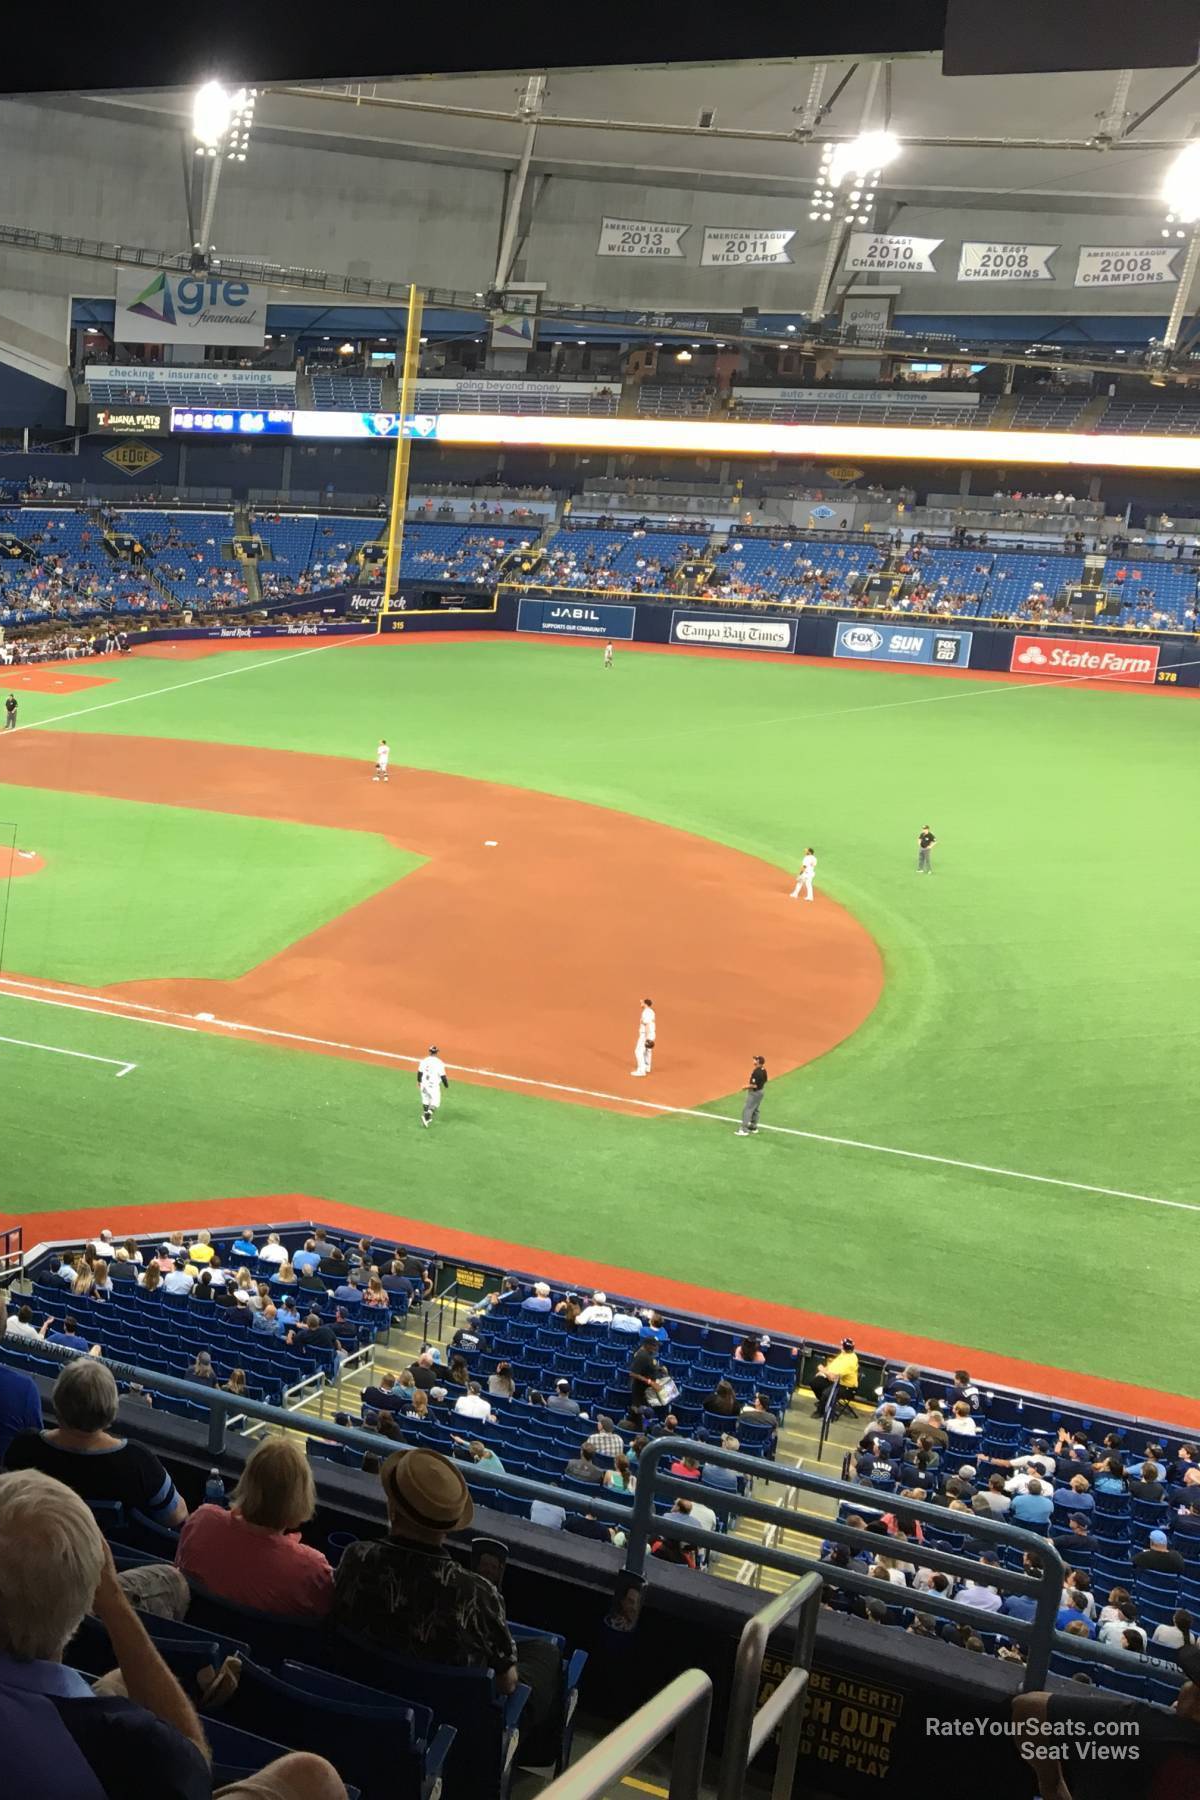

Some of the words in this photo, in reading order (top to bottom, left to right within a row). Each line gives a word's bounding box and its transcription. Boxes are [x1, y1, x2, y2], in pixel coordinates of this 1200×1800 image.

[604, 223, 646, 232] AMERICAN
[649, 225, 681, 234] LEAGUE
[620, 231, 663, 246] 2013
[707, 232, 750, 240] AMERICAN
[753, 232, 787, 240] LEAGUE
[873, 237, 887, 245] AL
[607, 244, 635, 253] WILD
[639, 246, 671, 255] CARD
[725, 240, 768, 254] 2011
[866, 245, 914, 260] 2010
[986, 246, 998, 254] AL
[999, 246, 1028, 254] EAST
[711, 253, 740, 262] WILD
[745, 253, 778, 262] CARD
[1087, 250, 1131, 258] AMERICAN
[851, 258, 923, 270] CHAMPIONS
[980, 254, 1029, 268] 2008
[1099, 257, 1152, 273] 2008
[964, 268, 1040, 278] CHAMPIONS
[1082, 272, 1164, 282] CHAMPIONS
[188, 309, 257, 328] financial
[850, 310, 881, 321] going
[108, 369, 155, 380] checking
[168, 370, 218, 380] insurance
[232, 372, 272, 382] savings
[456, 381, 484, 391] going
[486, 381, 524, 392] beyond
[527, 384, 561, 392] money
[780, 390, 804, 399] auto
[817, 390, 850, 399] credit
[852, 390, 882, 400] cards
[896, 391, 928, 401] home
[115, 451, 149, 463] LEDGE
[351, 594, 379, 610] Hard
[551, 607, 599, 620] JABIL
[392, 621, 404, 630] 315
[542, 622, 566, 631] SUPPORTS
[576, 625, 607, 633] COMMUNITY
[682, 624, 721, 639] Tampa
[723, 626, 746, 641] Bay
[748, 627, 785, 642] Times
[851, 632, 873, 643] FOX
[890, 635, 924, 651] SUN
[937, 640, 956, 649] FOX
[936, 651, 954, 660] GO
[1158, 672, 1177, 682] 378
[809, 1672, 832, 1691] BE
[837, 1682, 898, 1711] ALERT!
[839, 1706, 897, 1744] OUT
[821, 1727, 890, 1762] LEAVING
[818, 1745, 839, 1763] OF
[845, 1754, 890, 1779] PLAY
